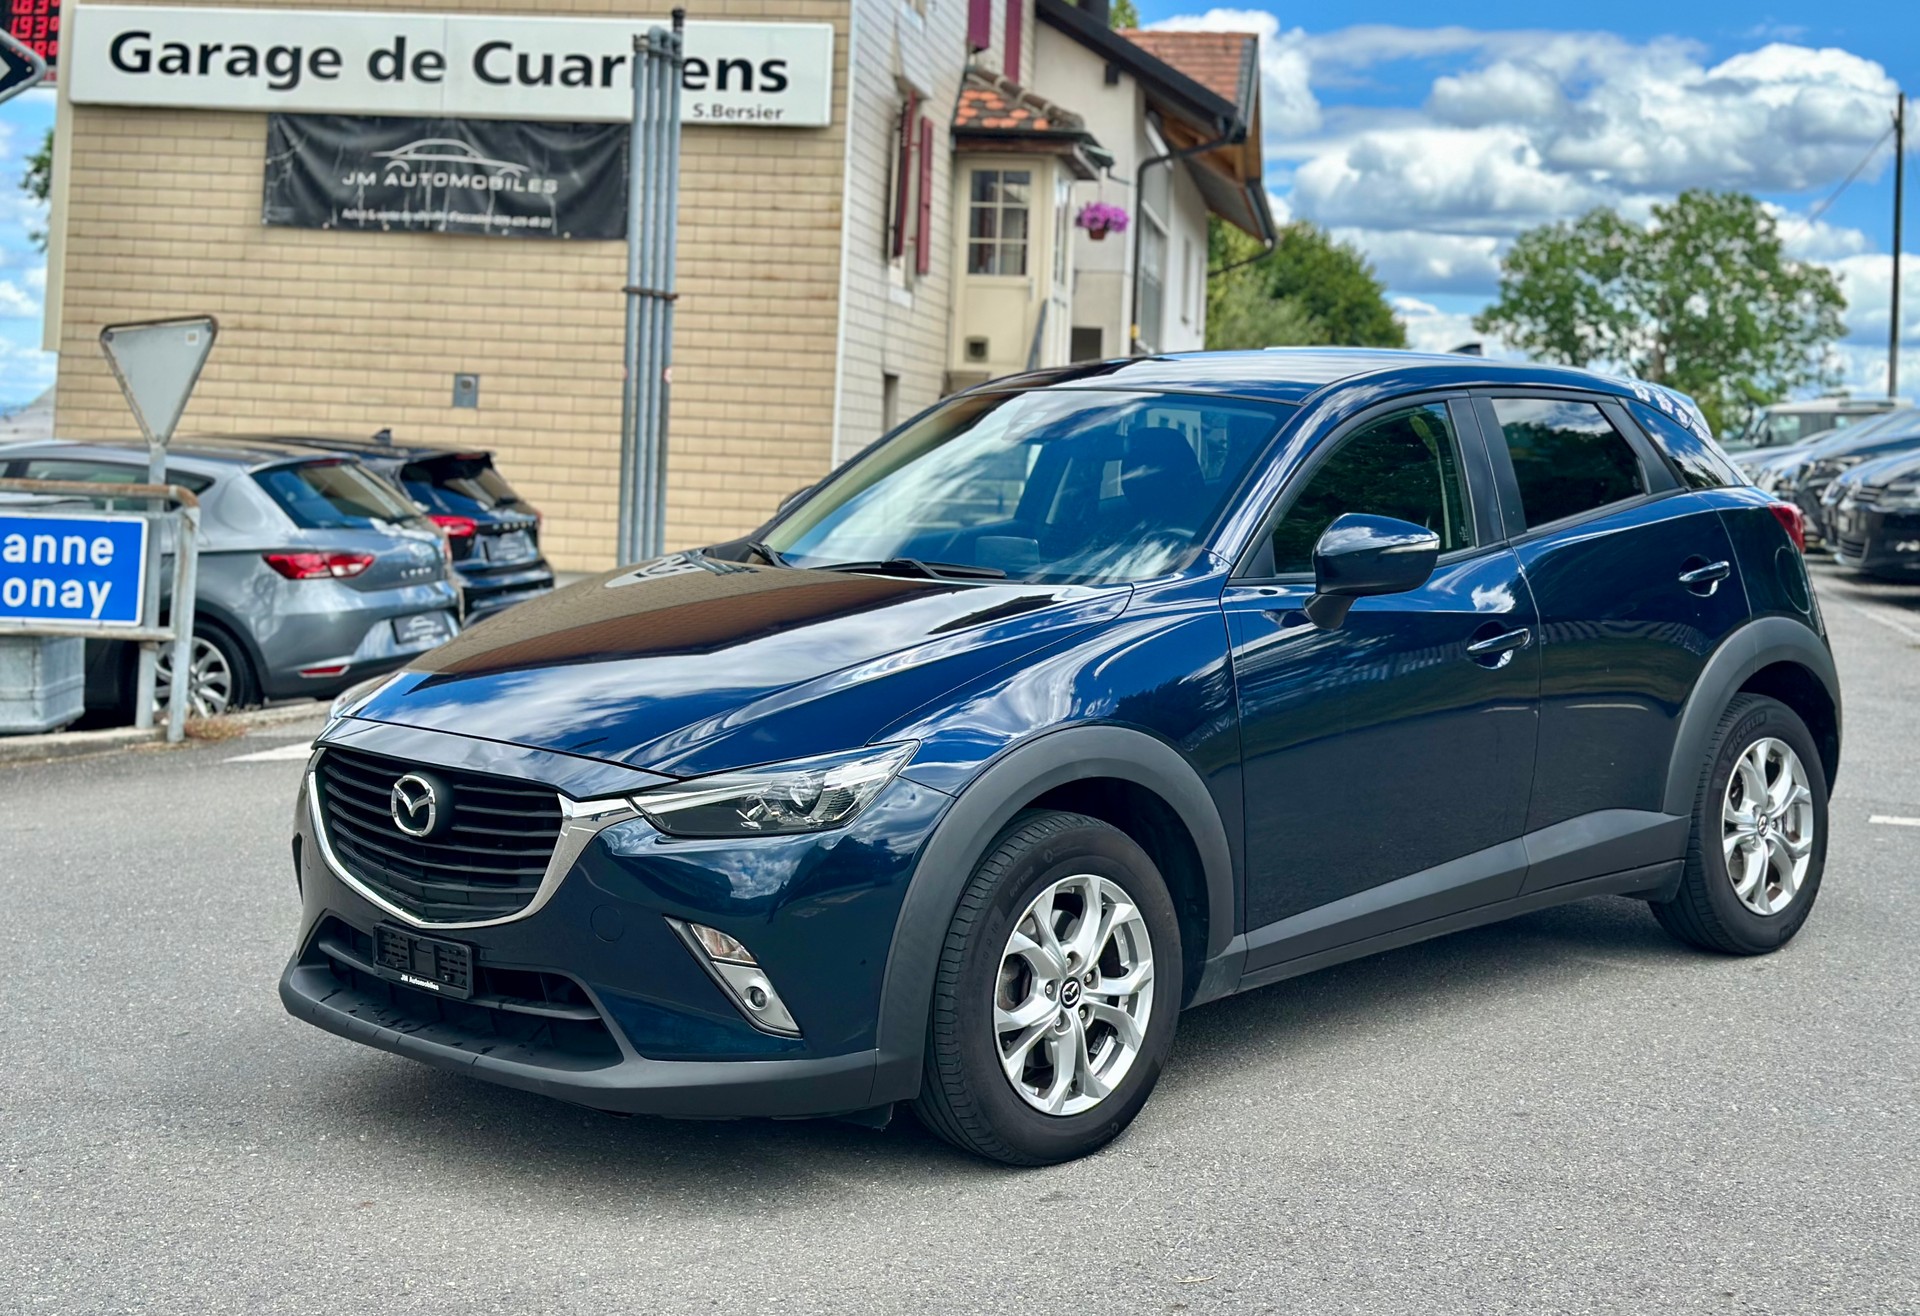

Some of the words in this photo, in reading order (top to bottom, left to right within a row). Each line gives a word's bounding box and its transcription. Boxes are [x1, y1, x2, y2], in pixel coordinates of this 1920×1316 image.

[110, 30, 343, 92] Garage
[367, 35, 447, 83] de
[472, 40, 789, 93] Cuarens
[693, 102, 785, 120] S.Bersier
[342, 171, 377, 186] JM
[383, 171, 559, 195] AUTOMOBILES
[2, 533, 115, 566] anne
[2, 577, 113, 619] onay
